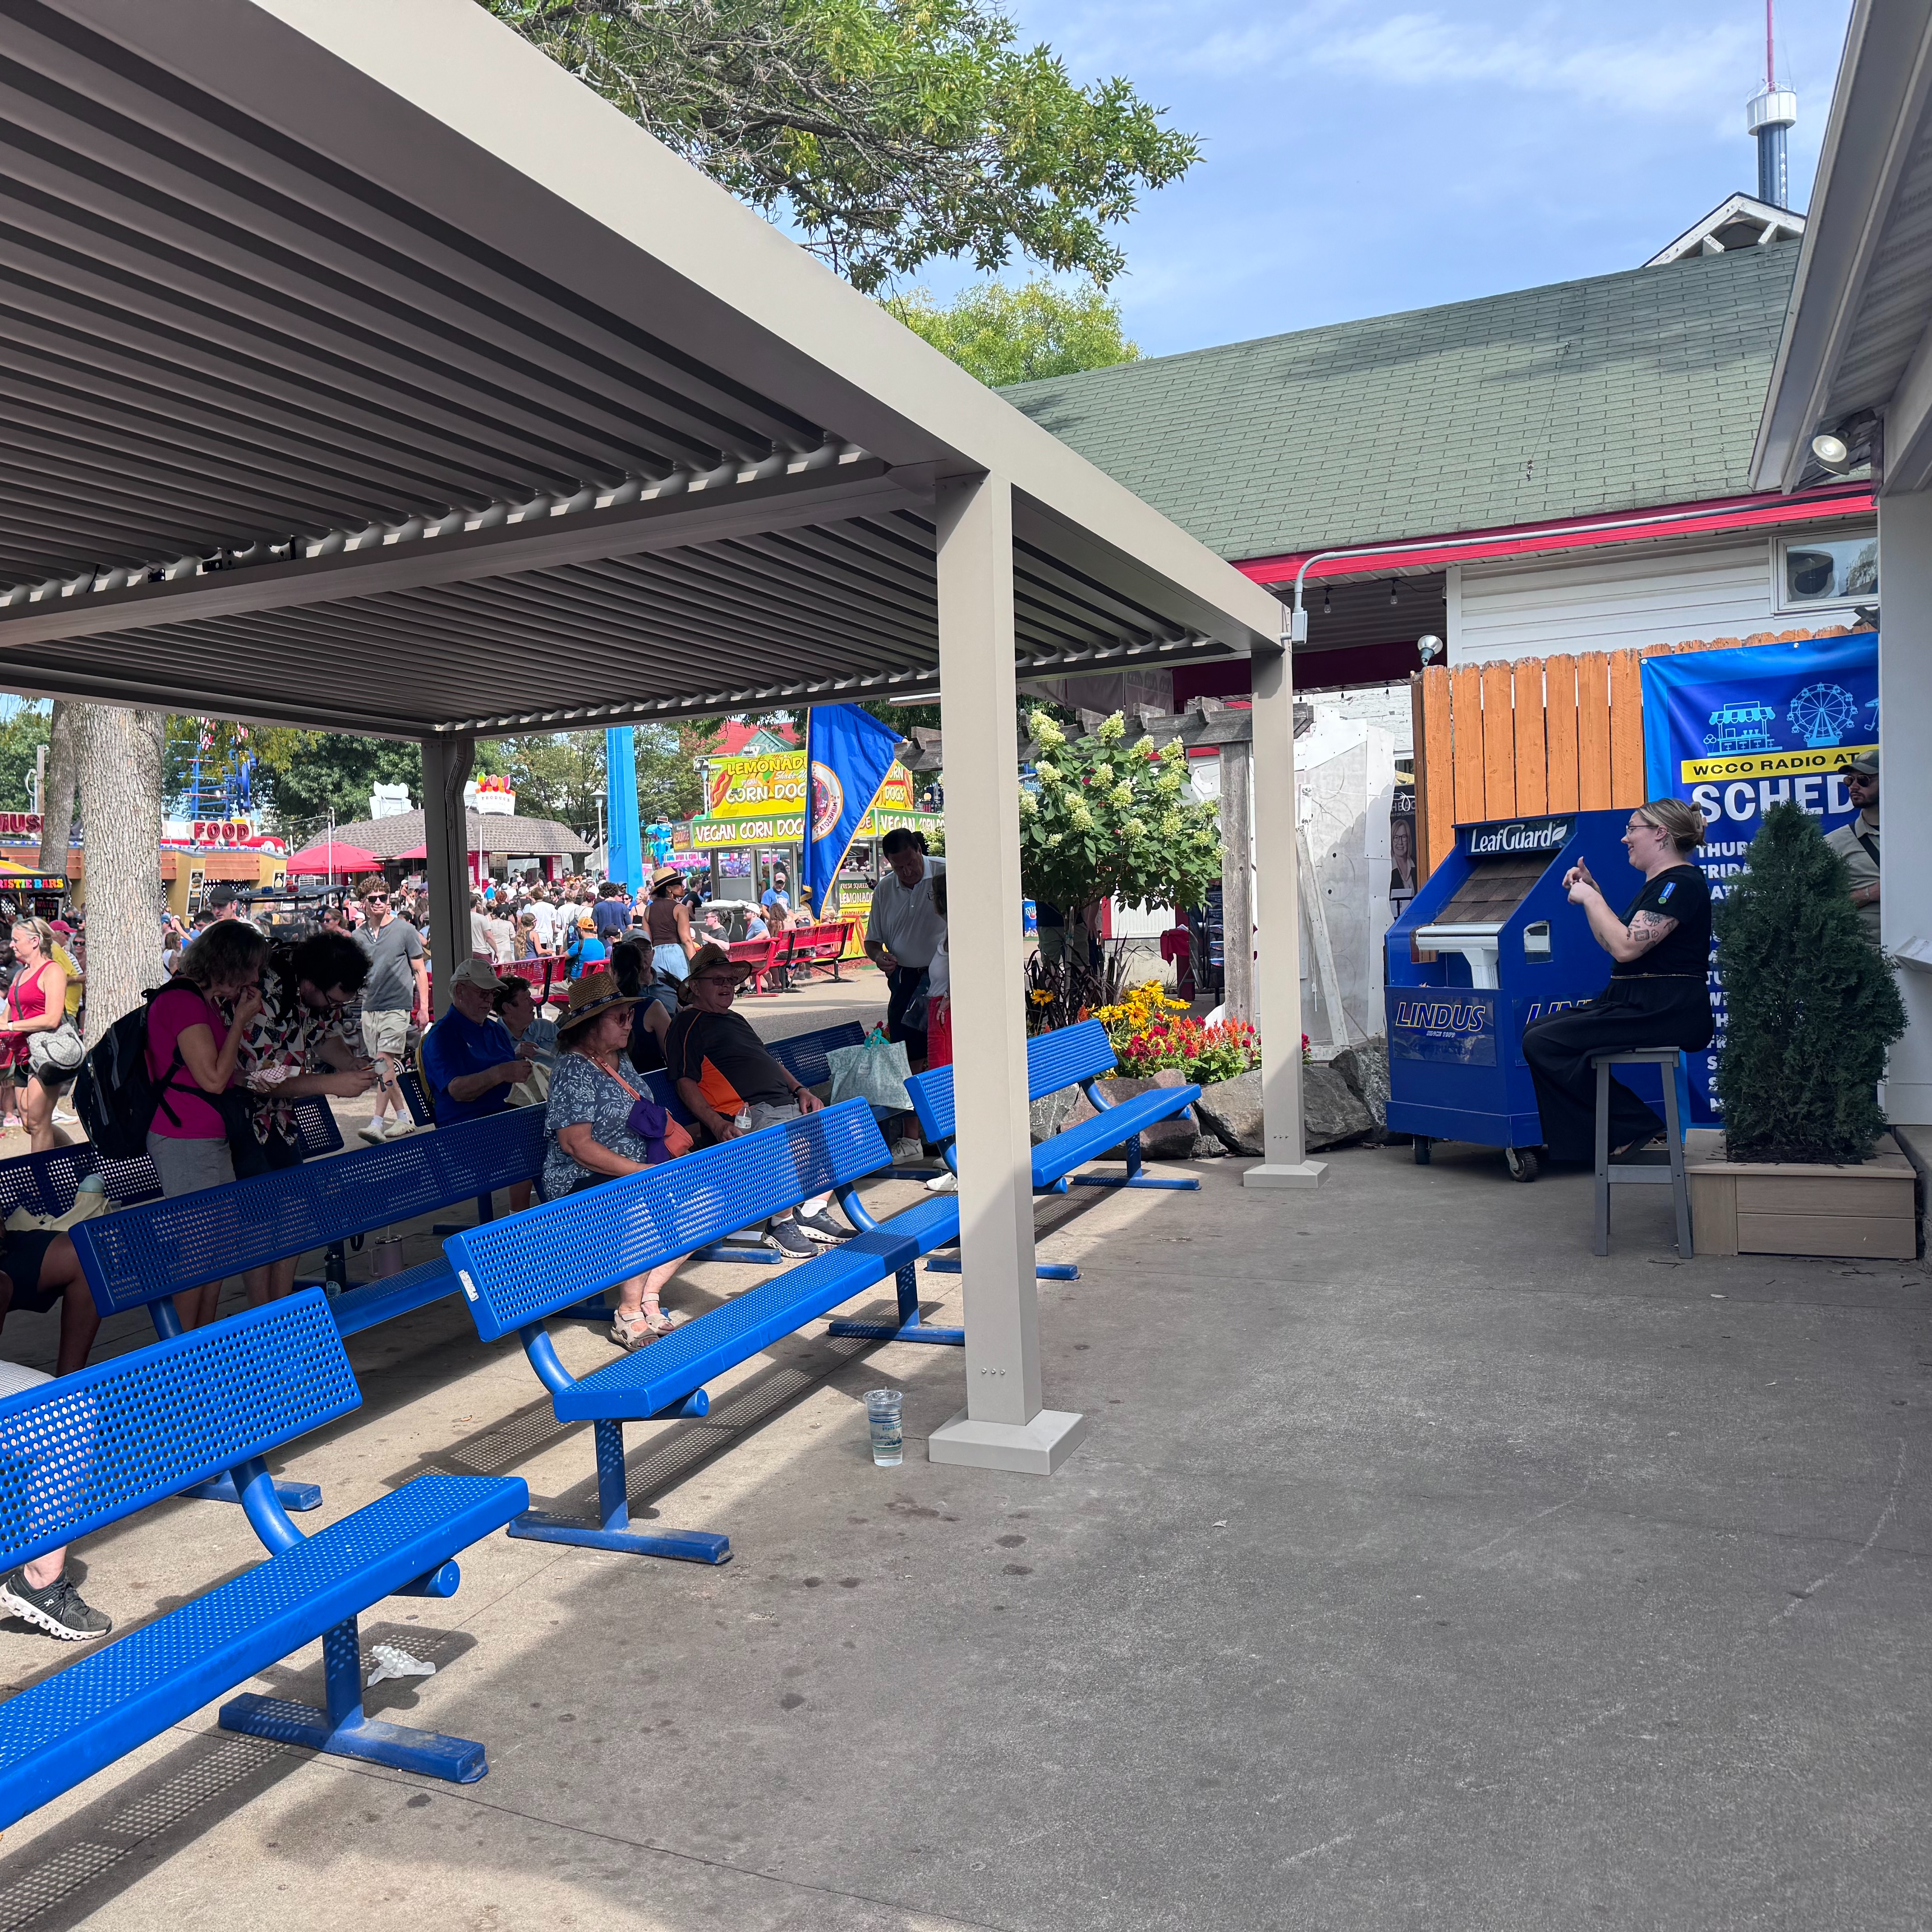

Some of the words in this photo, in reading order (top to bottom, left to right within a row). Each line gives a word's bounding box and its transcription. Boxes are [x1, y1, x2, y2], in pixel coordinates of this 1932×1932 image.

[1693, 762, 1754, 776] WCCO
[1761, 755, 1826, 771] RADIO
[1833, 752, 1860, 764] AT
[725, 786, 768, 804] CORN
[885, 786, 905, 803] DOGS
[1692, 774, 1854, 823] SCHED
[194, 822, 249, 840] FOOD
[695, 823, 736, 842] VEGAN
[740, 821, 773, 839] CORN
[777, 818, 805, 836] DOG
[880, 814, 915, 833] VEGAN
[1471, 821, 1553, 852] LeafGuard
[1696, 842, 1753, 858] THUR
[34, 879, 64, 888] BARS
[1396, 1002, 1486, 1032] LINDUS
